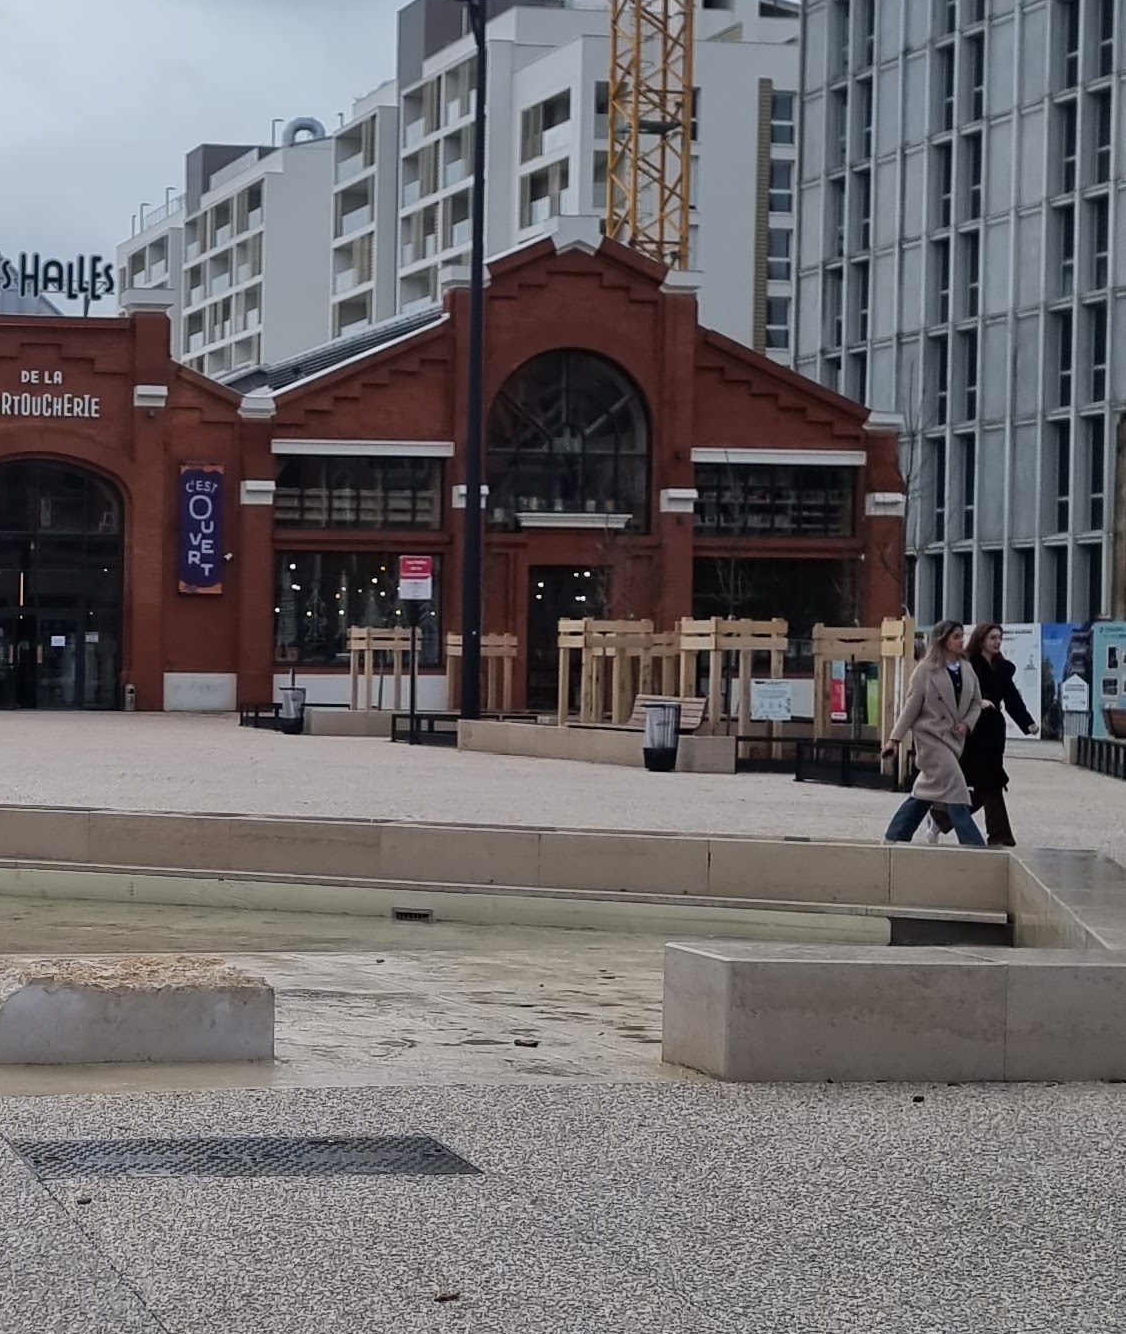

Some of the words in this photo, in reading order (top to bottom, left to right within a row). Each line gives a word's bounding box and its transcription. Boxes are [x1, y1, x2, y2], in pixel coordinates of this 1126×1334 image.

[20, 253, 115, 300] HALLES
[21, 370, 40, 384] DE
[44, 370, 63, 385] LA
[185, 480, 219, 494] C'EST
